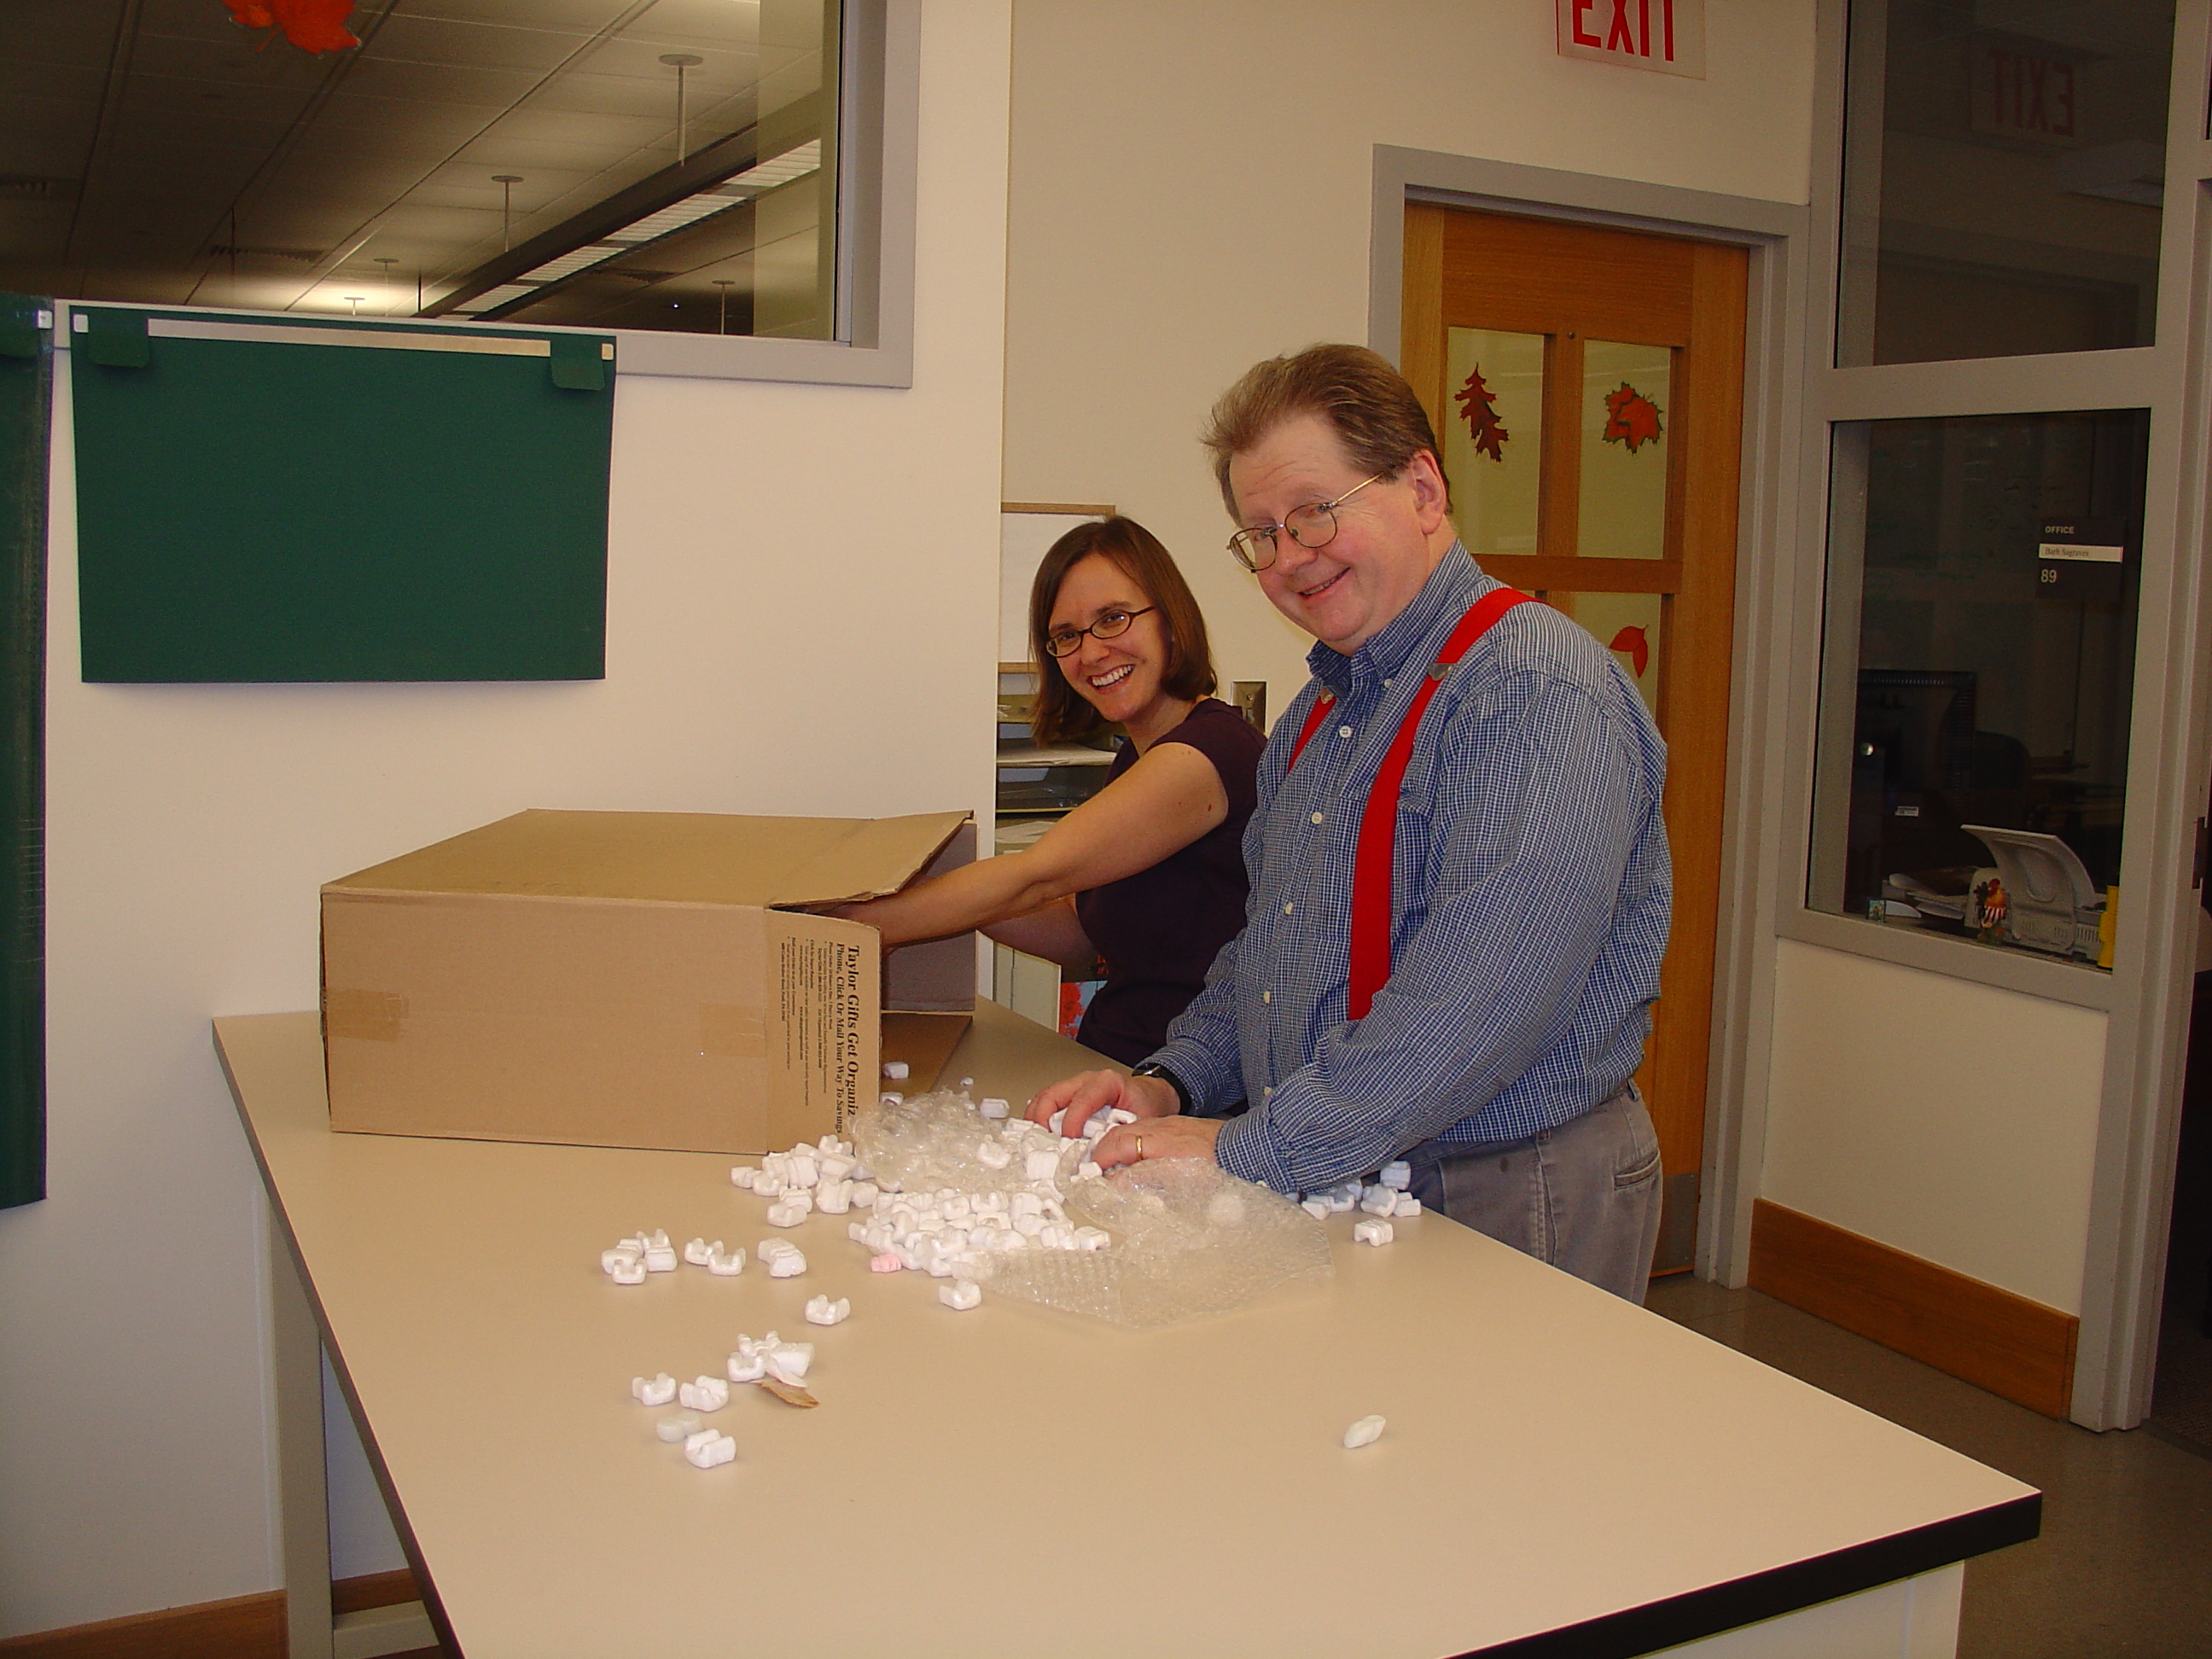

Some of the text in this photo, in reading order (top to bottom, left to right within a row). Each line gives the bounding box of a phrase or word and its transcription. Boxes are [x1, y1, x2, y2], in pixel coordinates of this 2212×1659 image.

[1572, 0, 1674, 61] EXIT
[2045, 526, 2075, 534] OFFICE
[2040, 568, 2057, 583] 89
[835, 943, 845, 973] Phone,
[836, 976, 846, 1001] Click
[836, 1002, 846, 1016] Or
[845, 944, 860, 1116] Taylor Gifts Get Organiz
[835, 1040, 845, 1063] Your
[834, 1064, 845, 1086] Way
[835, 1086, 845, 1099] To
[835, 1099, 844, 1134] Savings
